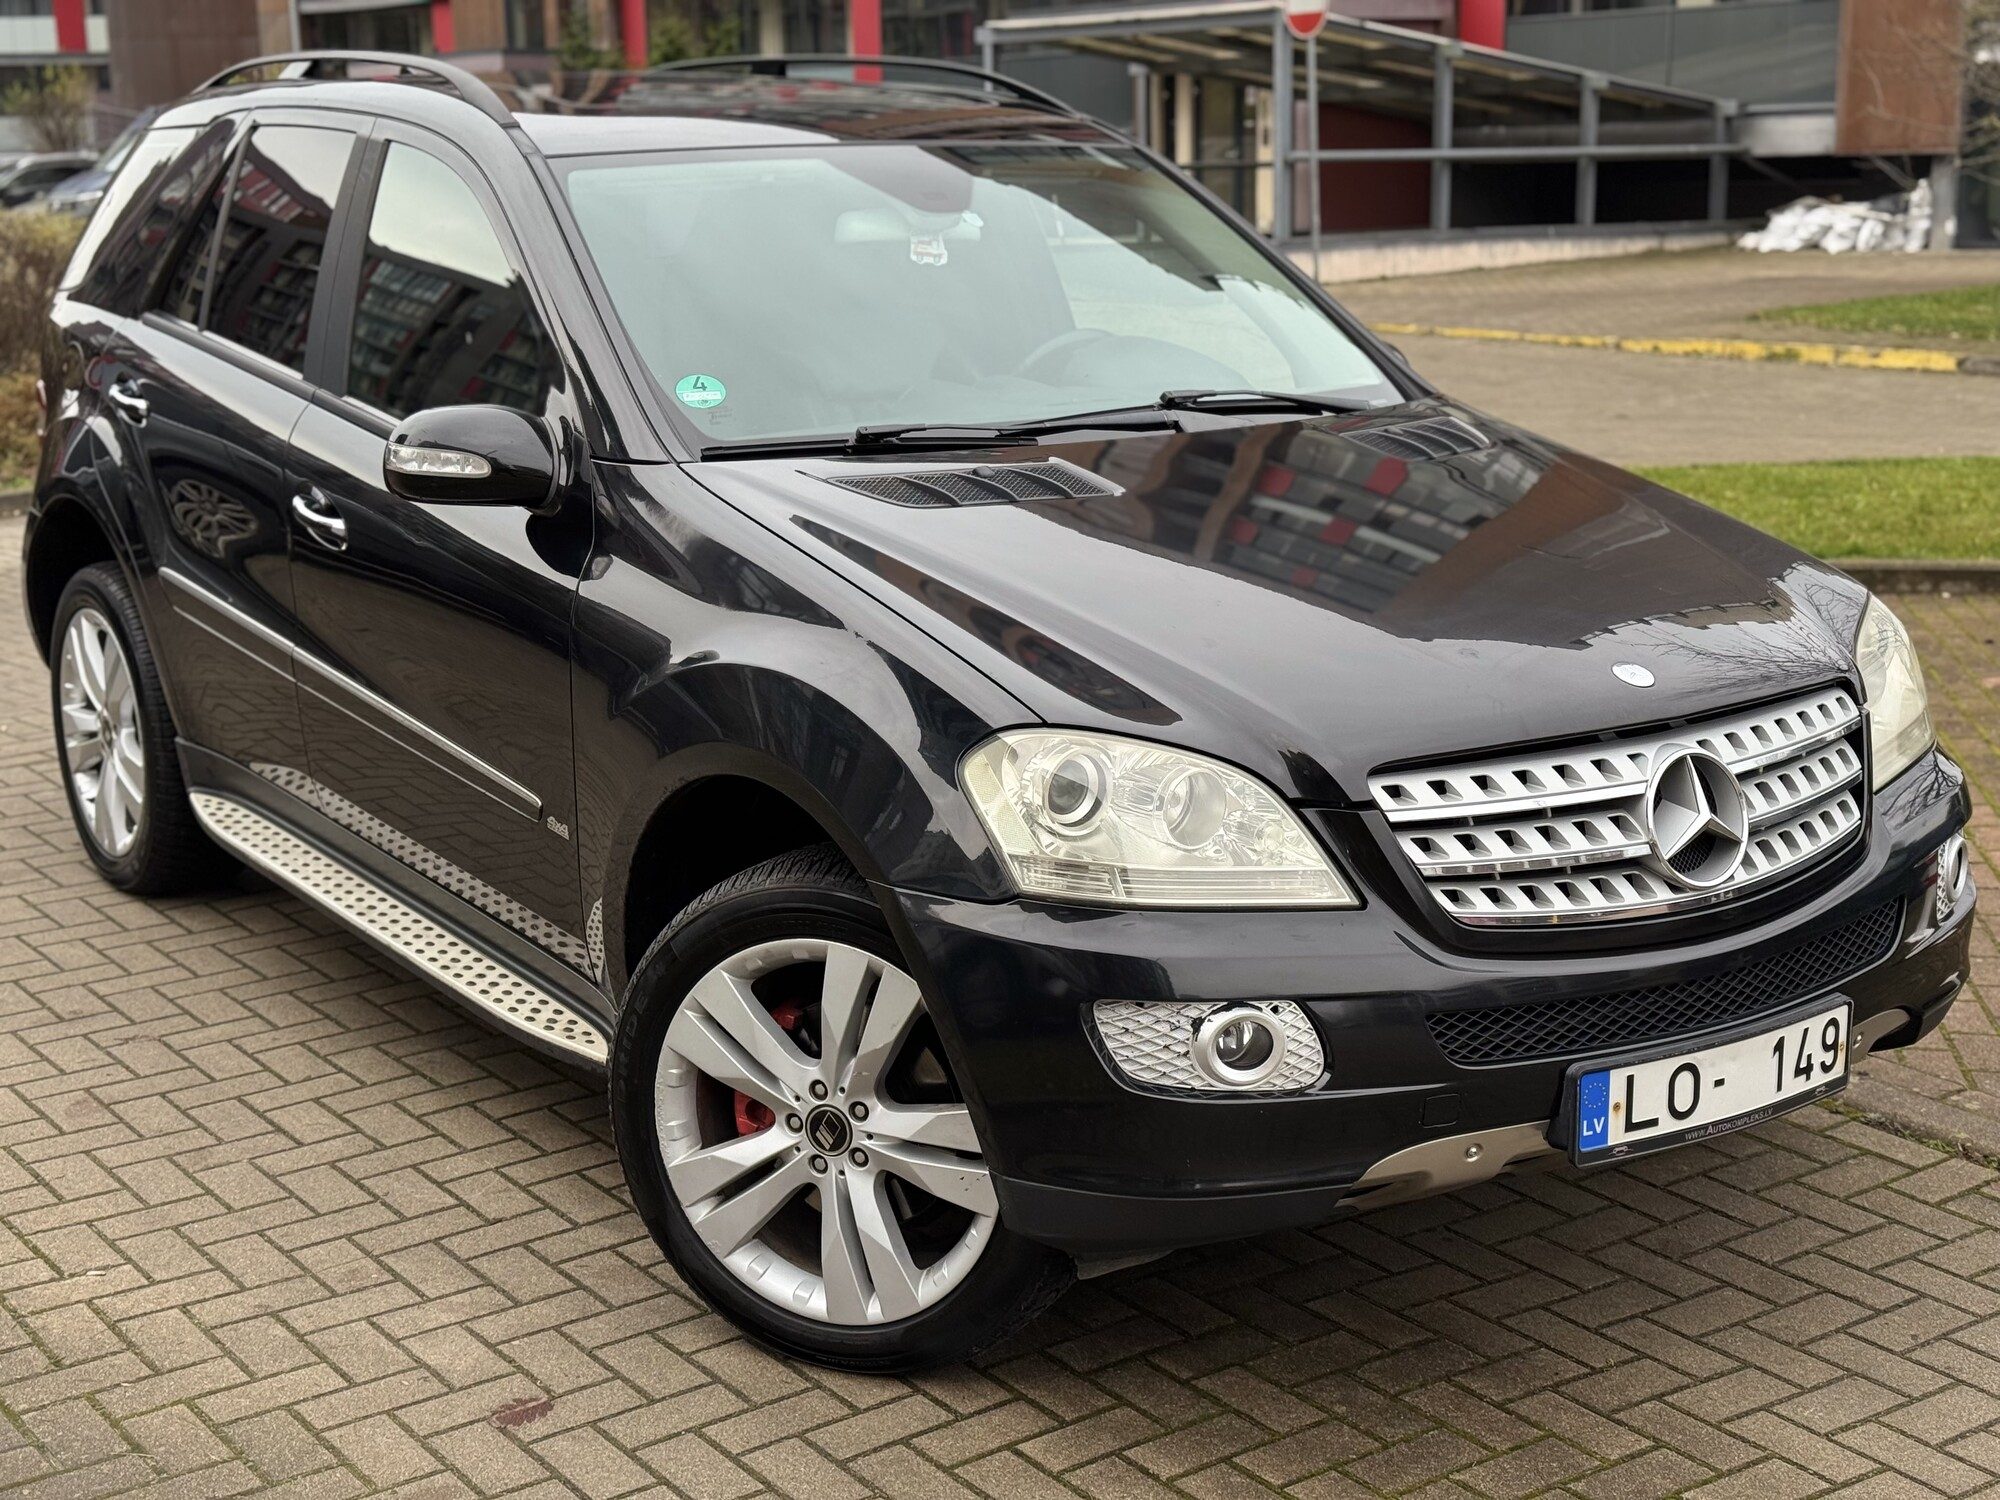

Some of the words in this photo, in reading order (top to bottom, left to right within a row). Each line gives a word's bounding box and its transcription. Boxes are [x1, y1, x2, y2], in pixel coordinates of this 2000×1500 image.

[693, 376, 707, 391] 4
[1772, 1016, 1840, 1093] 149
[1583, 1117, 1605, 1137] LV
